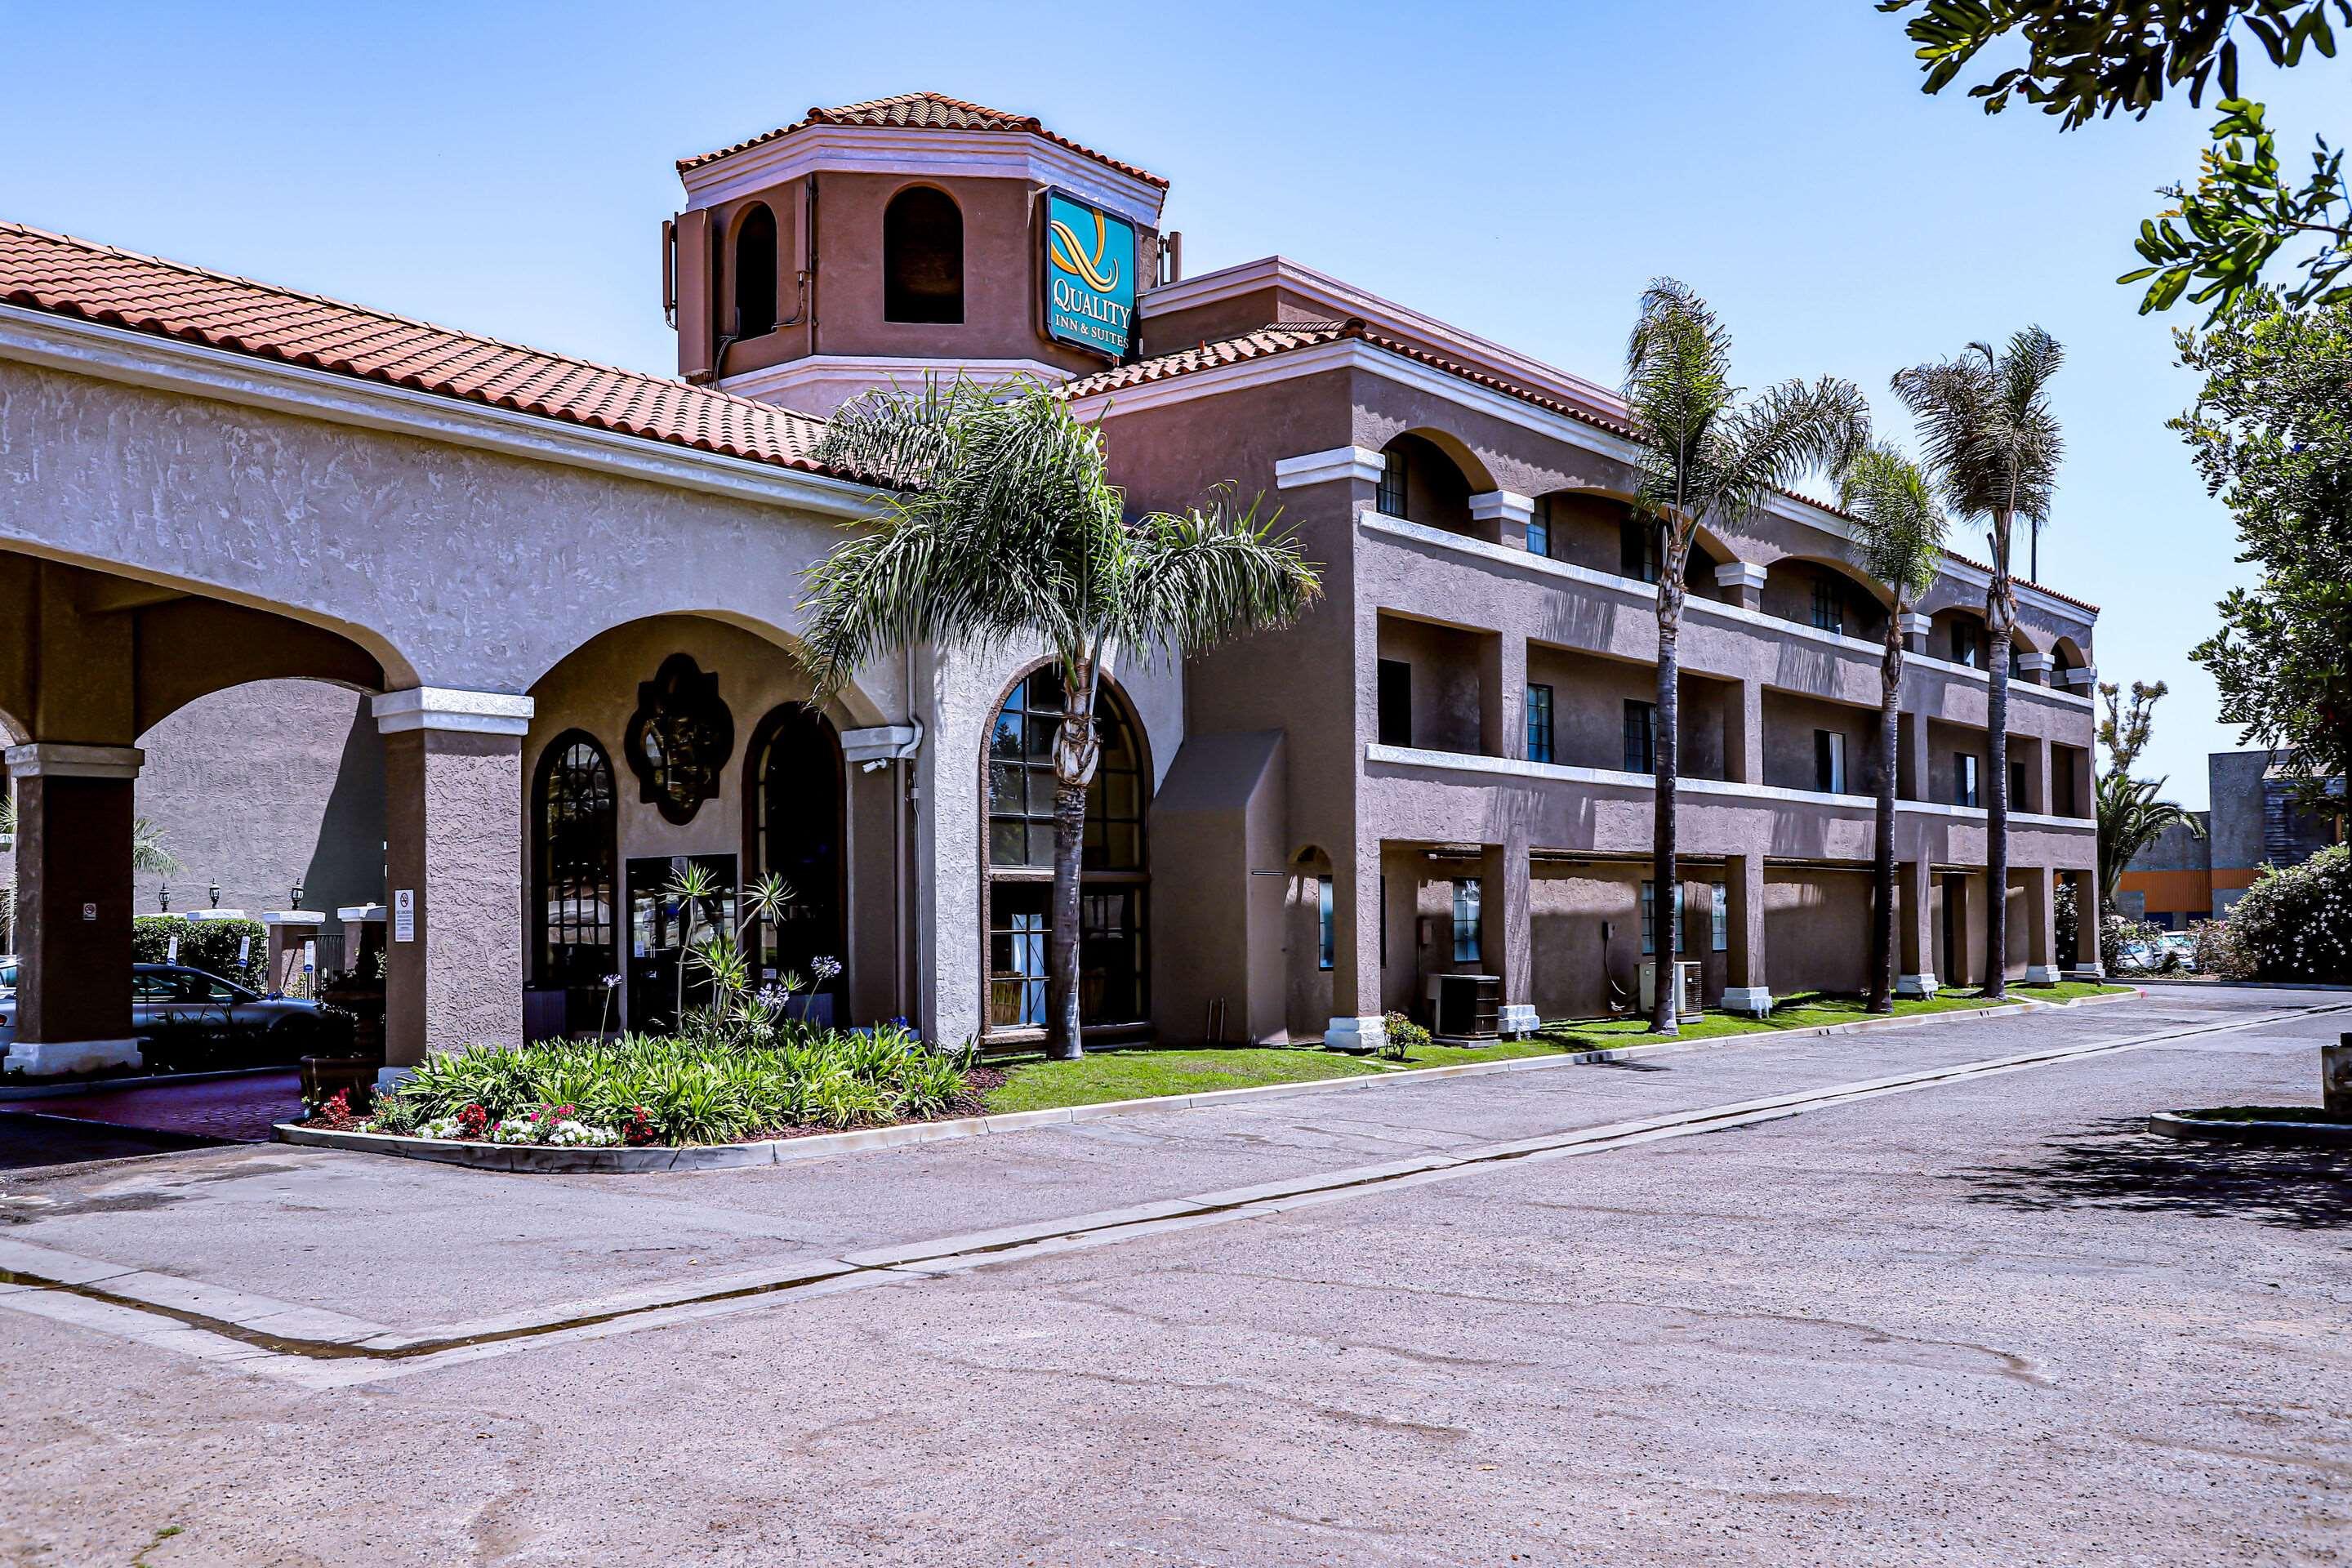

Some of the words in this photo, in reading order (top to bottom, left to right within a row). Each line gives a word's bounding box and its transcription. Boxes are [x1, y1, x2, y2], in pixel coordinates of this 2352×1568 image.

[1054, 278, 1130, 329] QUALITY
[1055, 314, 1077, 332] INN
[1080, 323, 1089, 335] &
[1091, 326, 1129, 349] SUITES
